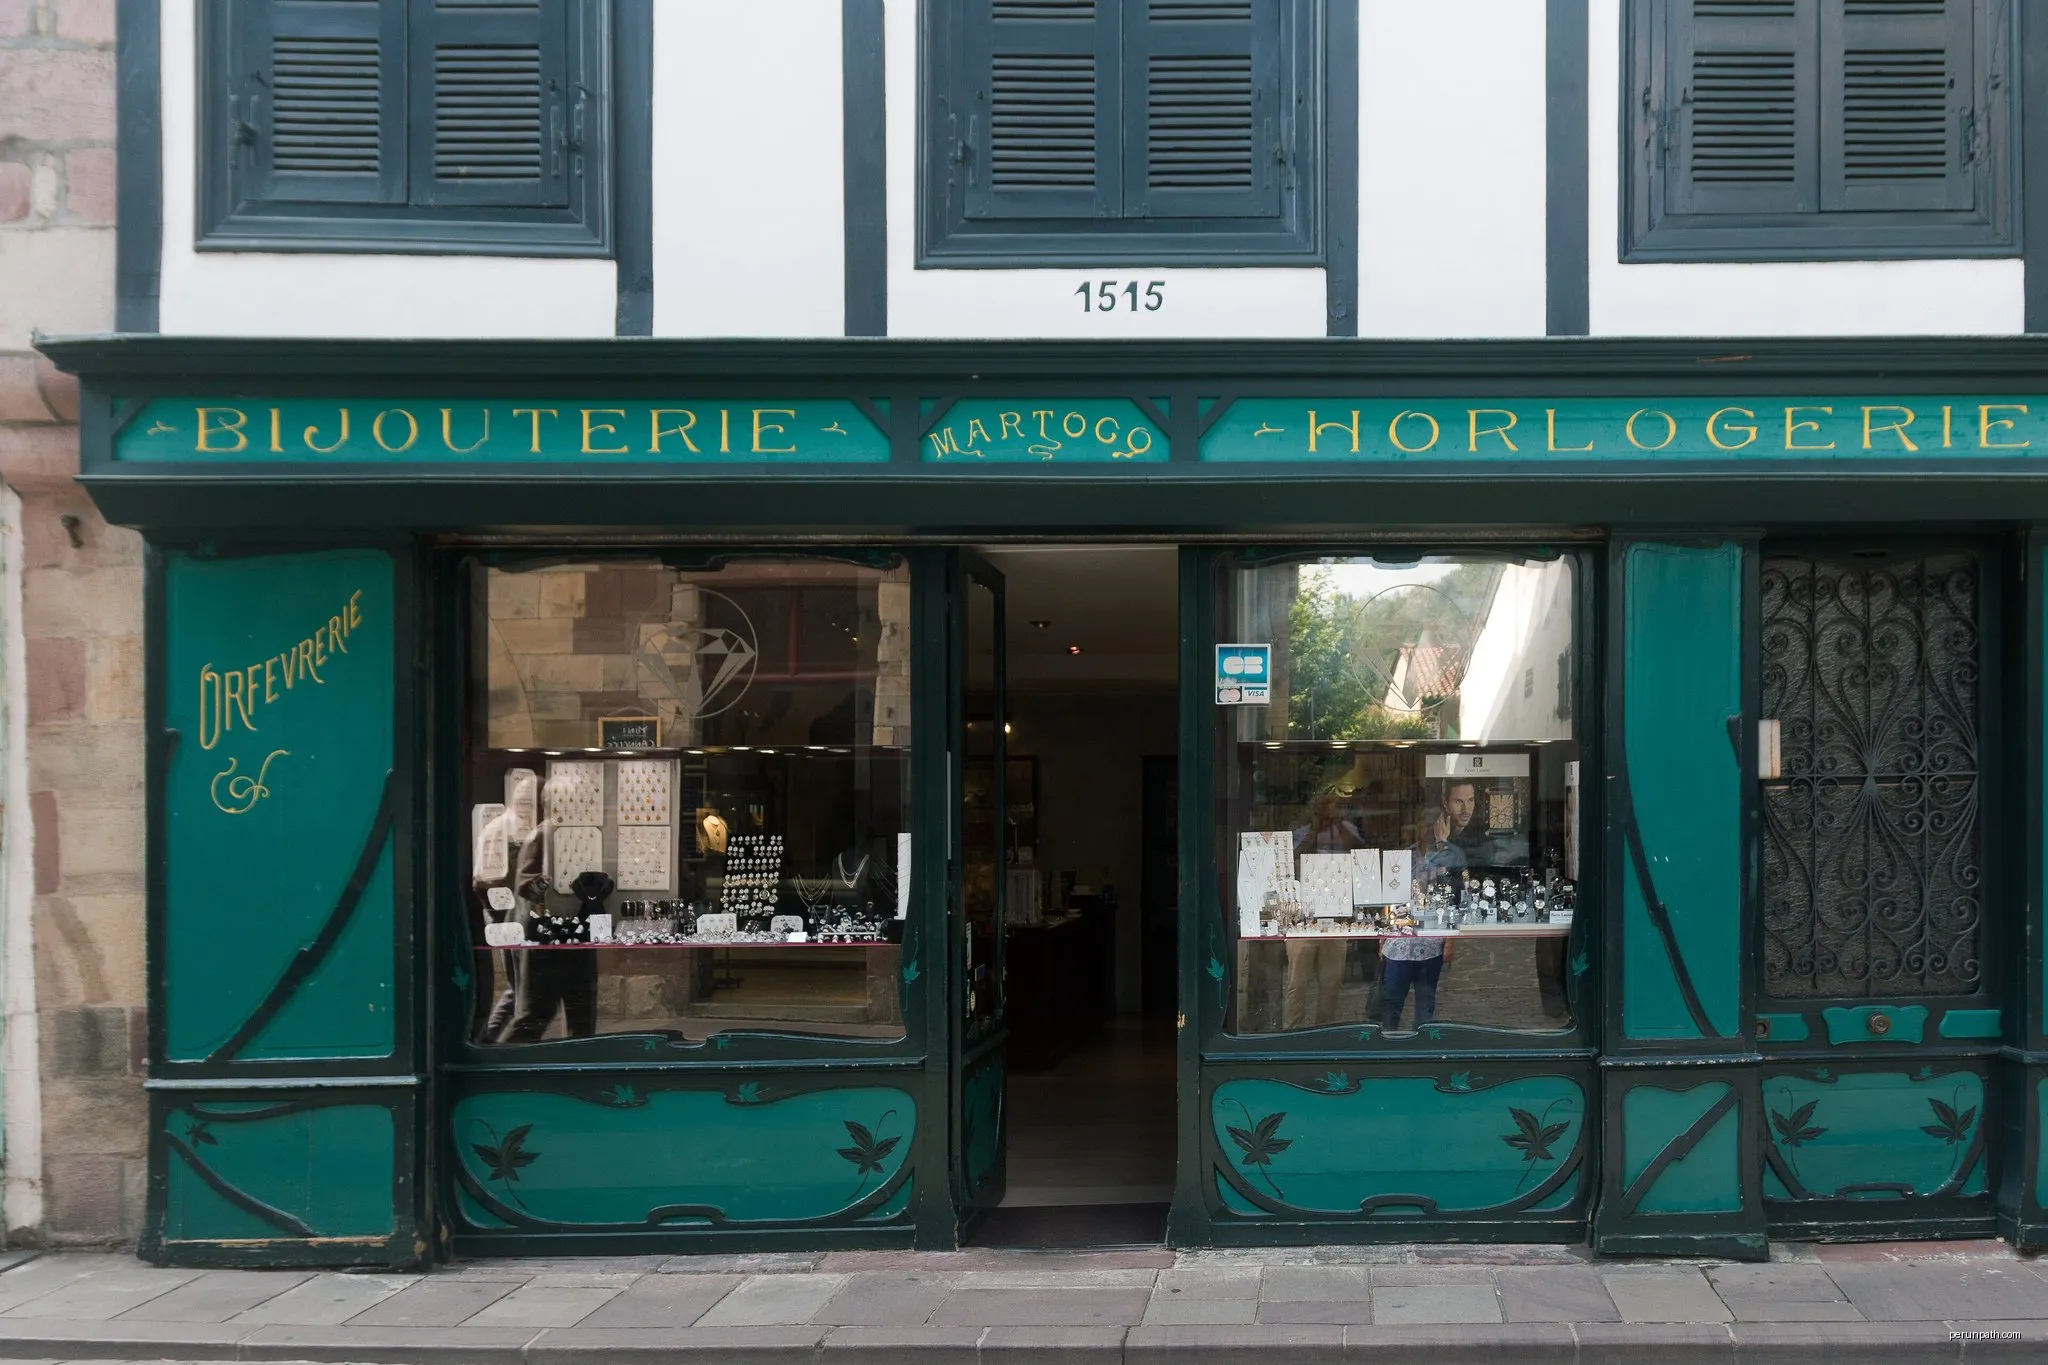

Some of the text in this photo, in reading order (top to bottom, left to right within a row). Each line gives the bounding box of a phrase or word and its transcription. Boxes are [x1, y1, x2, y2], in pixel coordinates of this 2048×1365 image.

[1073, 280, 1166, 312] 1515
[194, 406, 797, 455] BIJOUTERIE
[1307, 404, 2031, 454] HORLOGERIE
[199, 588, 363, 750] ORFEVRERIE
